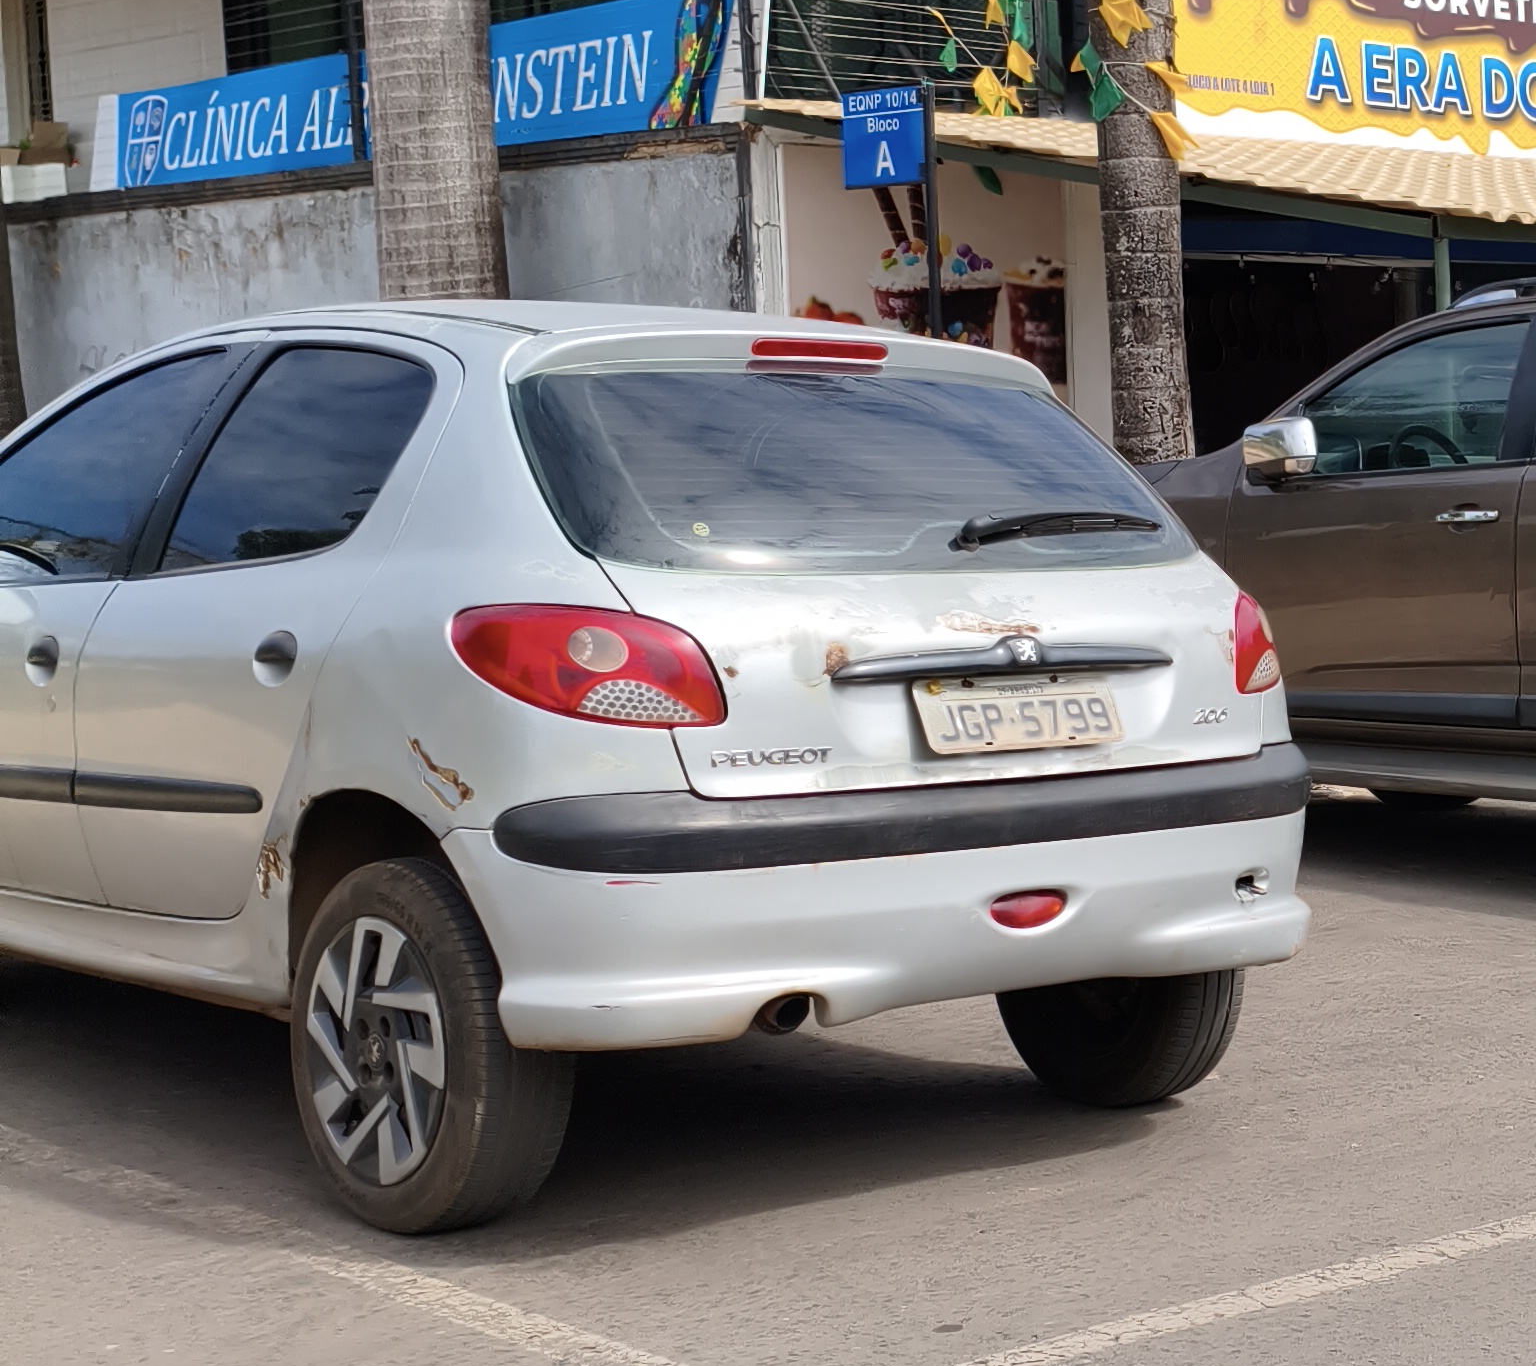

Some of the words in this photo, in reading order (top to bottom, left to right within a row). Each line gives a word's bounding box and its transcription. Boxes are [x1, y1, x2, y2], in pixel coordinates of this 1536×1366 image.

[1306, 35, 1352, 104] A
[1361, 40, 1473, 116] ERA
[163, 89, 288, 171] CLÍNICA
[490, 29, 653, 124] NSTEIN
[848, 93, 882, 112] EQNP
[885, 89, 918, 109] 10/14
[866, 116, 900, 134] Bloco
[875, 140, 896, 178] A
[1192, 707, 1229, 725] 206
[710, 745, 835, 768] PEUGEOT
